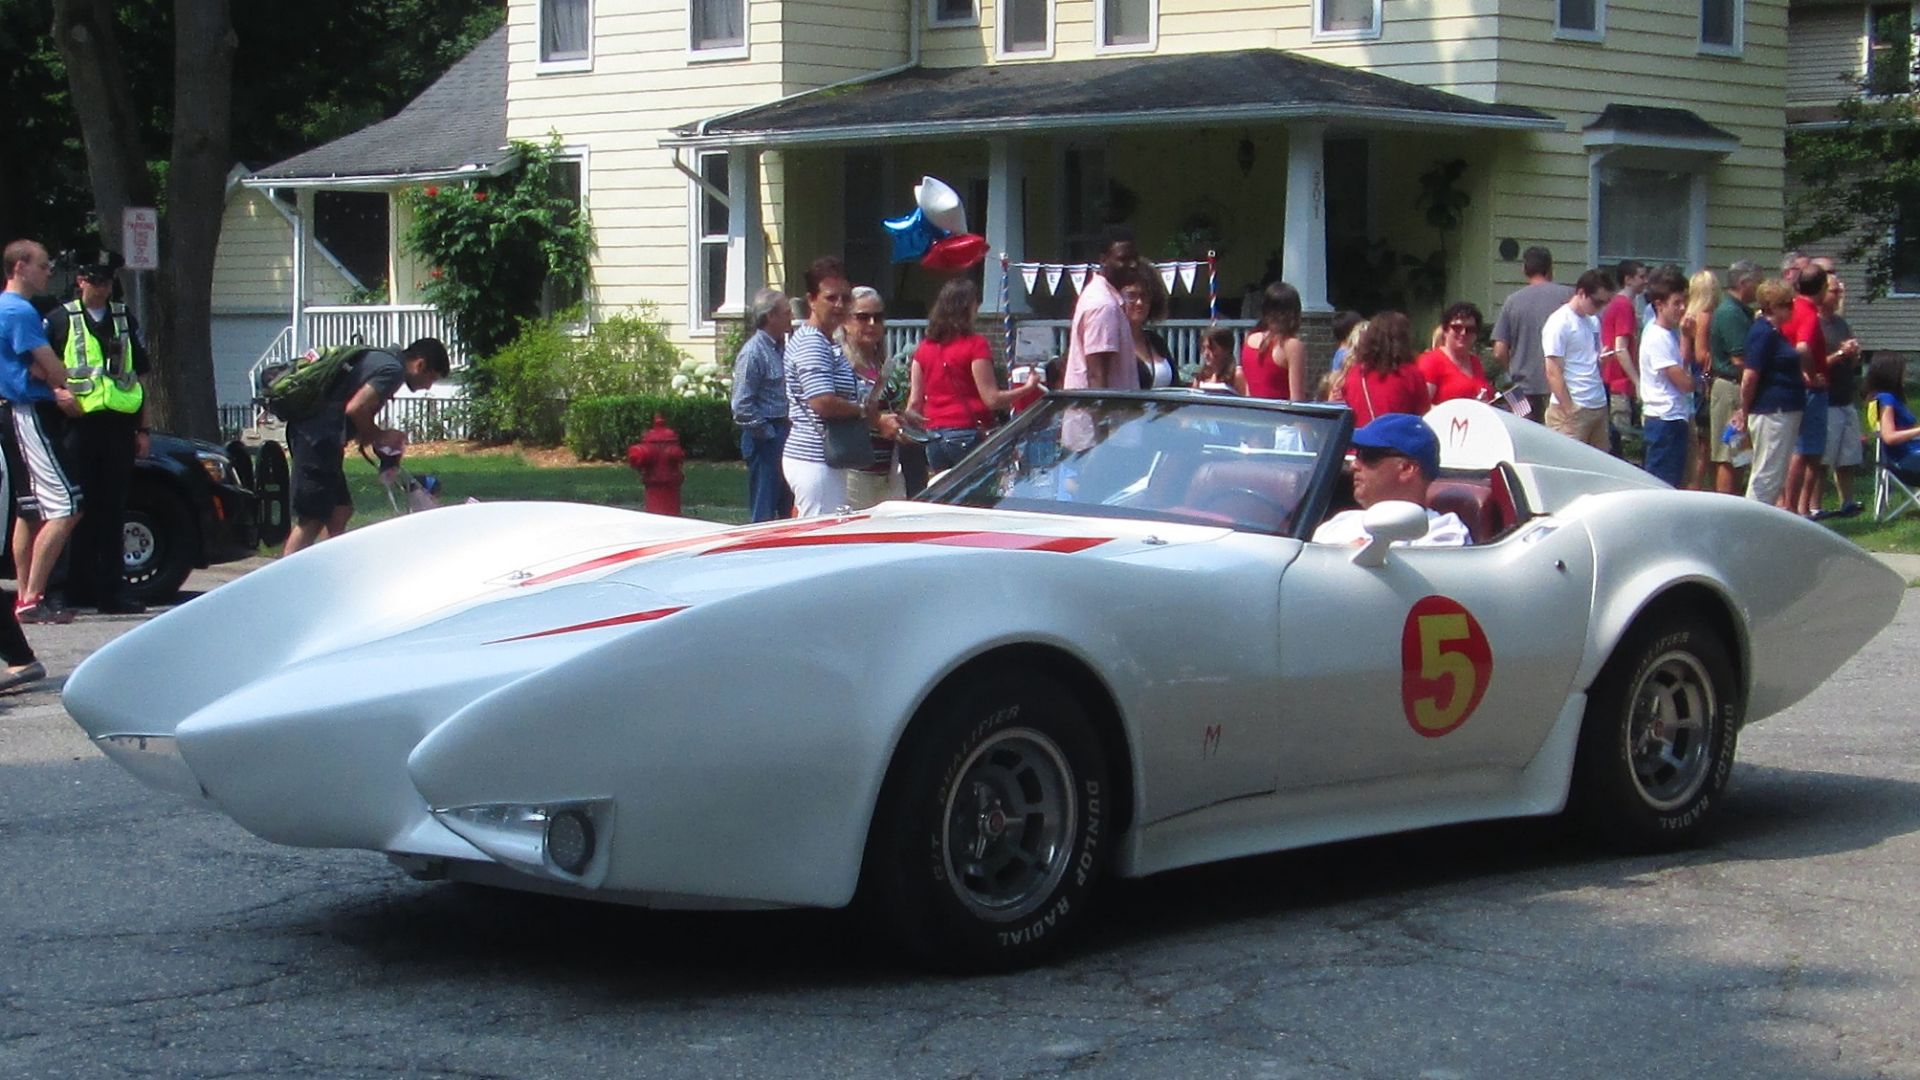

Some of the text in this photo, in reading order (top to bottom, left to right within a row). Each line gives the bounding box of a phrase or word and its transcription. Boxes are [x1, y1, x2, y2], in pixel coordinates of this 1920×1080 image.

[1450, 416, 1469, 447] M
[1413, 613, 1476, 729] 5
[1203, 723, 1222, 760] M
[997, 779, 1101, 947] DUNLOP RADIAL
